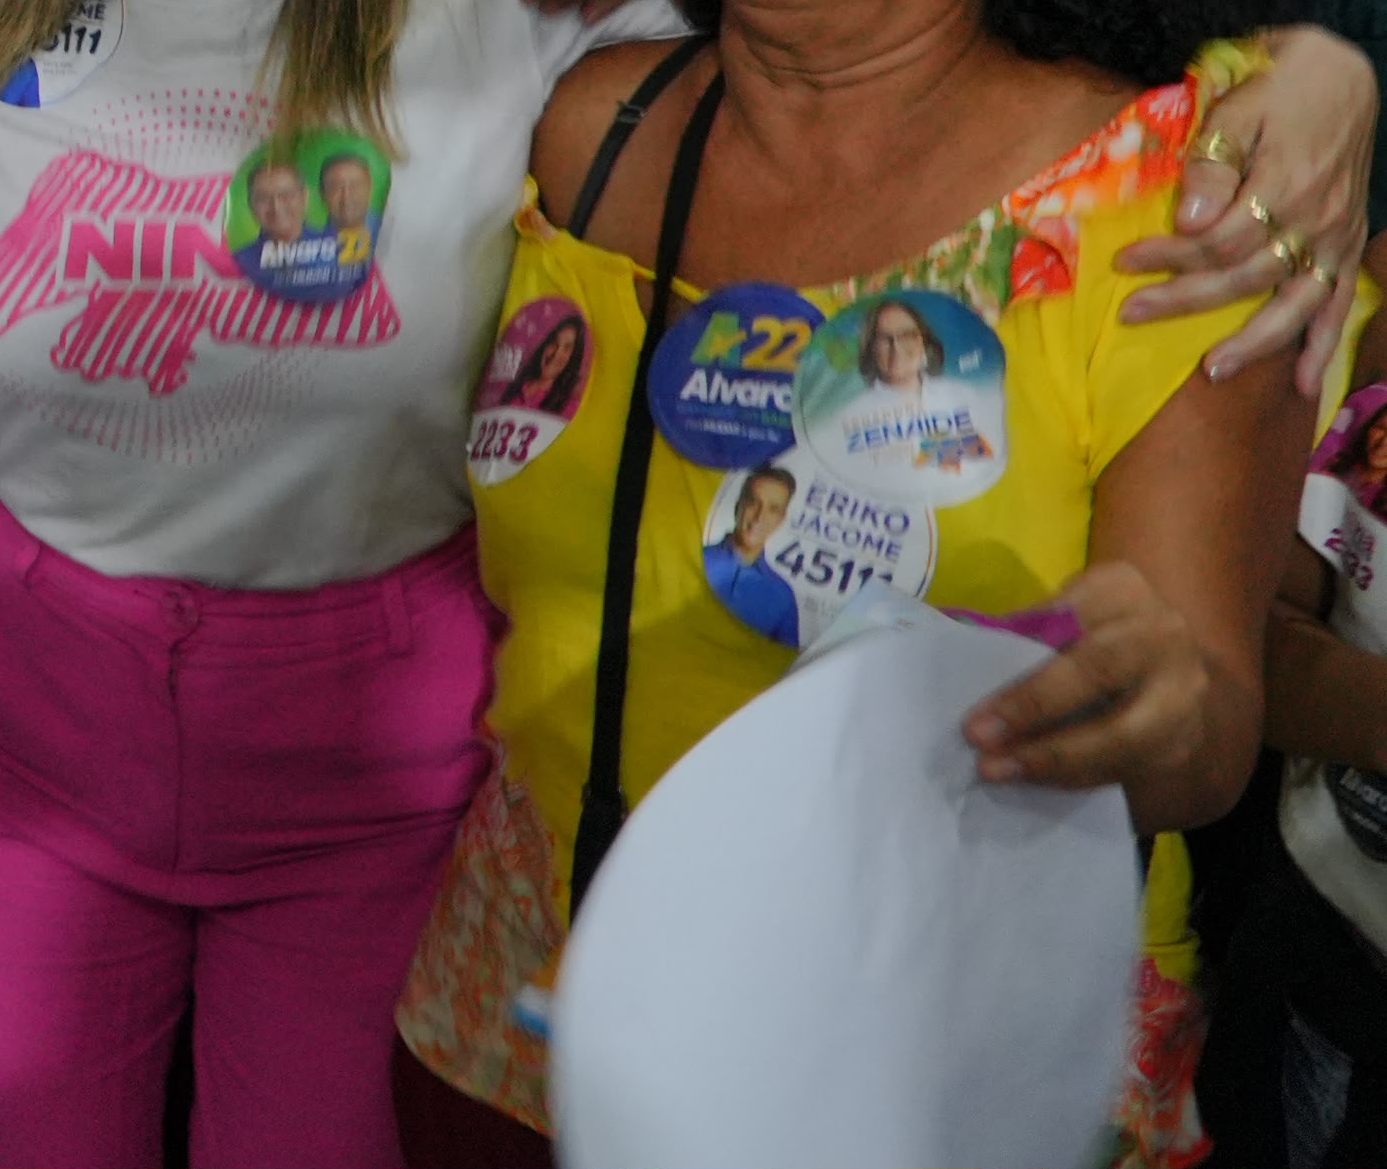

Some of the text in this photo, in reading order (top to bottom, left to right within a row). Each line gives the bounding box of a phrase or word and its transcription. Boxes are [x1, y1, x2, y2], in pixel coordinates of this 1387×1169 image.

[61, 218, 249, 284] NIN
[259, 236, 337, 269] Alvaro
[470, 417, 540, 464] 2233
[805, 479, 911, 535] ERIKO
